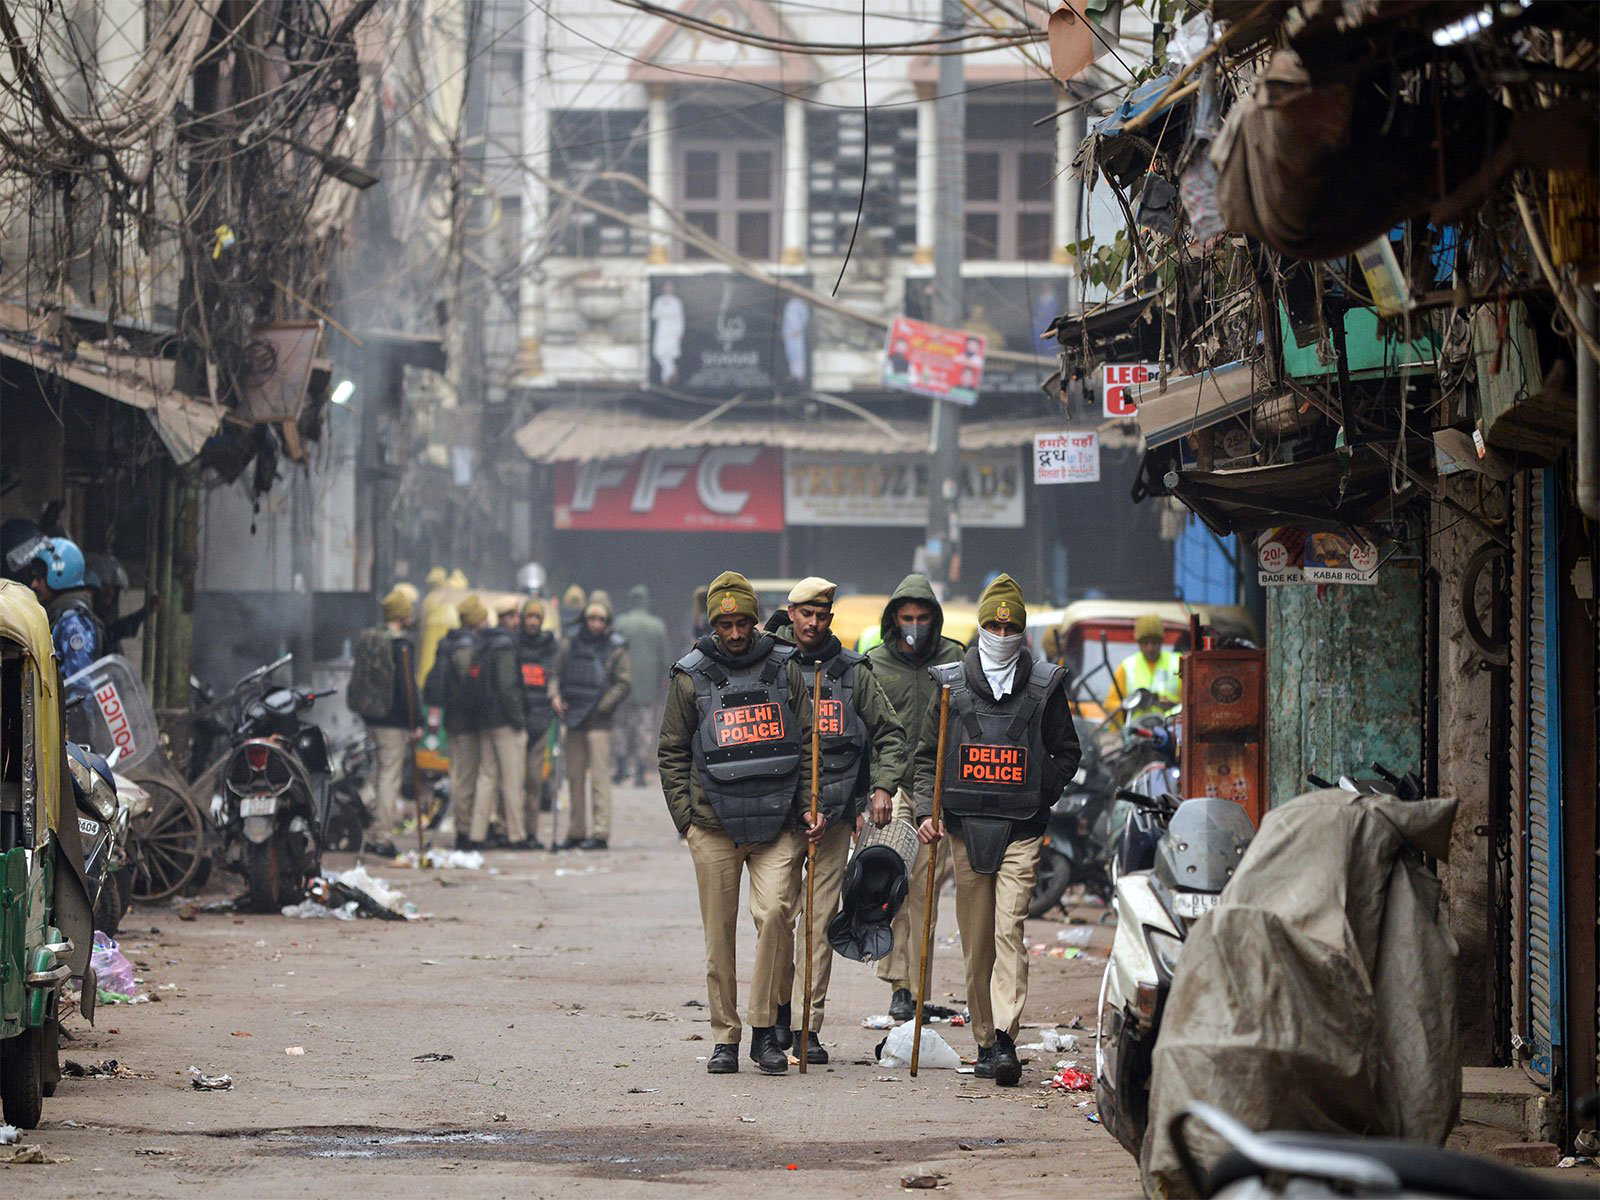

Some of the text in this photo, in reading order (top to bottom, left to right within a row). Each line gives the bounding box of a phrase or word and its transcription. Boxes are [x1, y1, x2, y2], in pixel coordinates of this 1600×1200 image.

[1106, 367, 1148, 384] LEG
[1037, 450, 1067, 468] दूध
[569, 447, 764, 514] FFC
[1262, 574, 1285, 583] BADE
[1286, 574, 1298, 582] KE
[1313, 570, 1343, 580] KABAB
[1345, 571, 1368, 581] ROLL
[97, 686, 134, 760] POLICE
[724, 706, 773, 726] DELHI
[721, 722, 780, 743] POLICE
[969, 747, 1019, 764] DELHI
[963, 764, 1023, 781] POLICE
